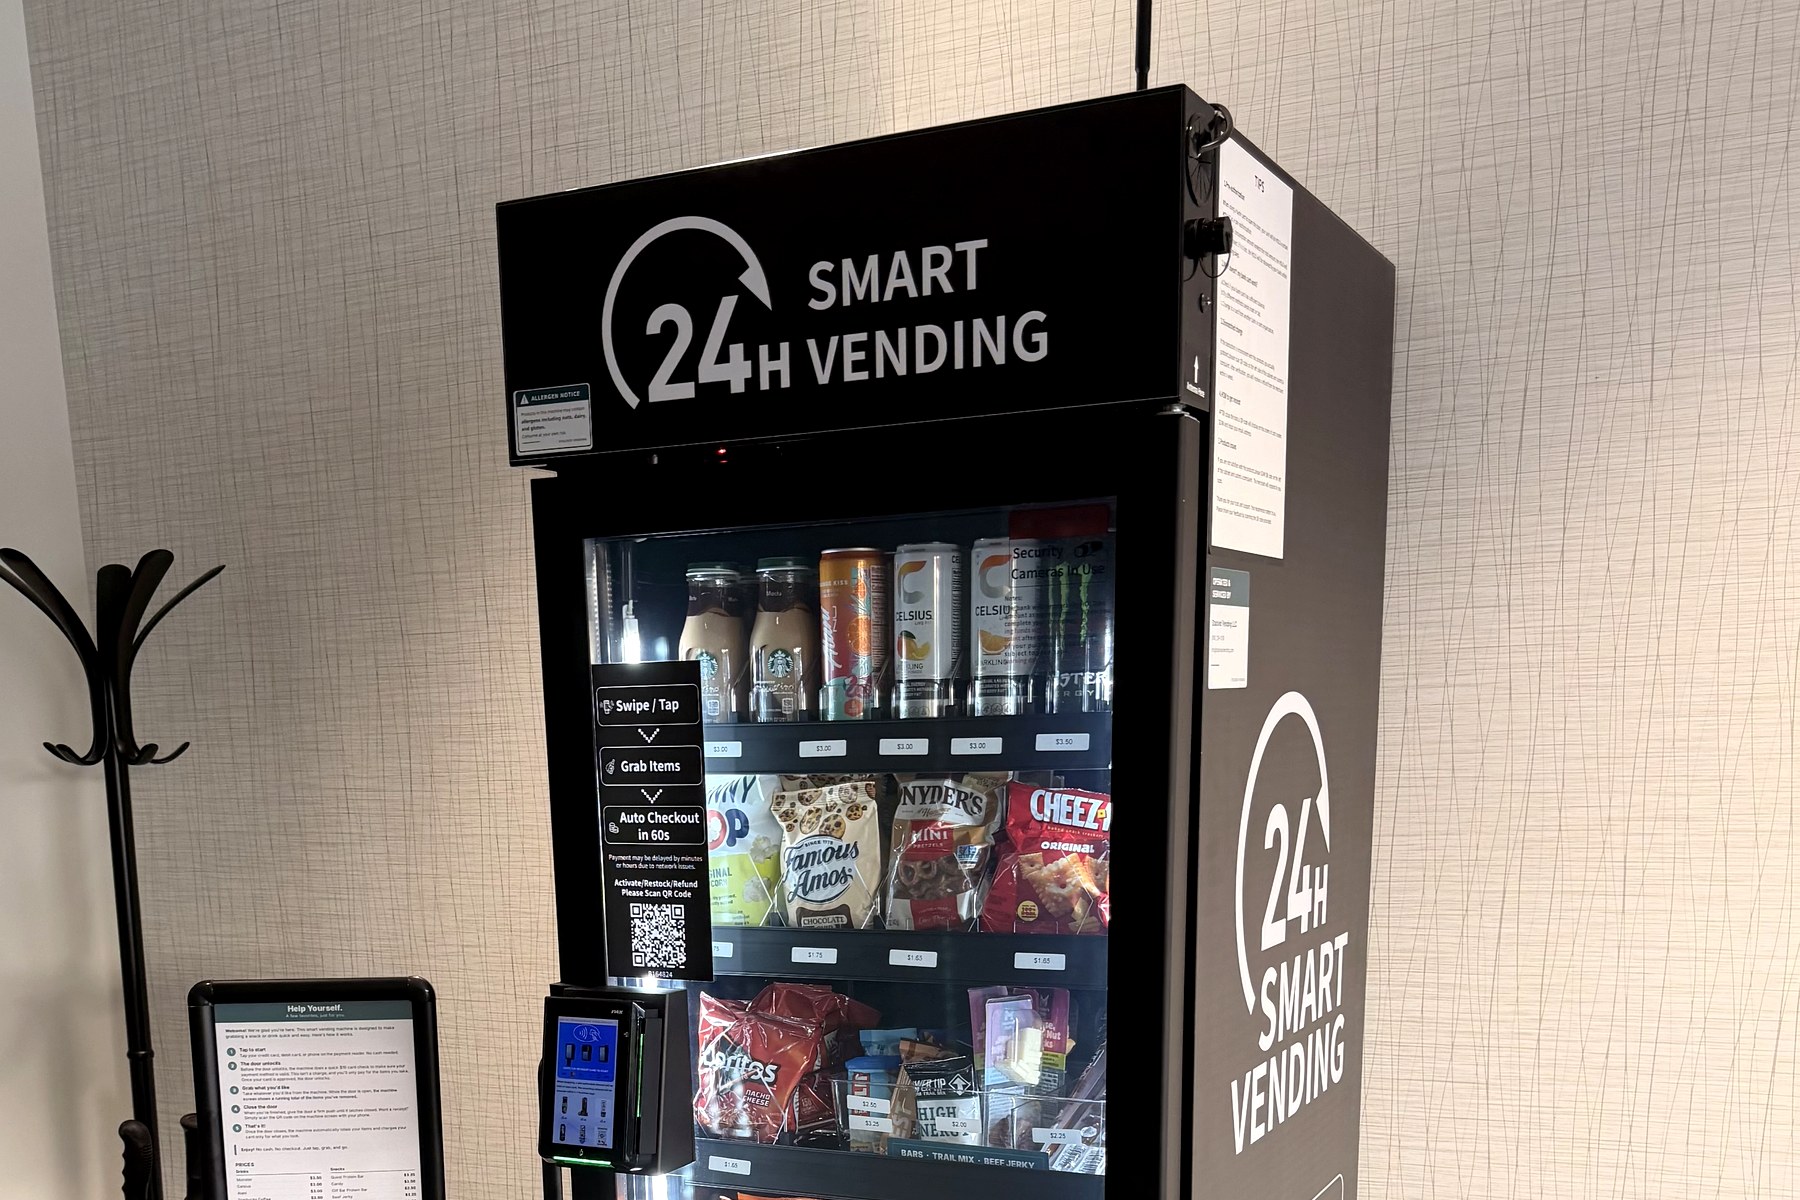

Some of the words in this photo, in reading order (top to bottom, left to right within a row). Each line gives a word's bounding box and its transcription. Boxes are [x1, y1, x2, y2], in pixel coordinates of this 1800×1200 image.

[807, 238, 988, 311] SMART
[645, 294, 790, 403] 24H
[806, 310, 1048, 385] VENDING
[1013, 545, 1063, 559] Security
[1011, 567, 1064, 580] Cameras
[1067, 564, 1077, 576] In
[1082, 563, 1105, 576] Use
[896, 610, 932, 621] CELSIUS
[615, 699, 650, 714] Swipe
[651, 698, 657, 714] /
[658, 698, 680, 713] Tap
[816, 744, 831, 752] $3.00
[969, 742, 986, 750] $3.00
[1055, 738, 1073, 746] $3.50
[620, 760, 647, 773] Grab
[649, 760, 681, 772] Items
[620, 812, 645, 824] Auto
[647, 812, 700, 824] Checkout
[638, 829, 649, 841] in
[650, 829, 670, 841] 60s
[911, 829, 949, 842] MINI
[1040, 841, 1095, 854] ORIGINAL
[608, 854, 632, 862] Payment
[651, 854, 673, 863] delayed
[673, 855, 681, 863] by
[783, 841, 860, 878] Famous
[1261, 797, 1329, 952] 24H
[614, 878, 698, 888] Activate/Restock/Refund
[787, 866, 854, 904] Amos
[621, 889, 644, 898] Please
[644, 889, 661, 898] Scan
[662, 890, 673, 898] QR
[673, 889, 692, 898] Code
[803, 916, 845, 925] CHOCOLATE
[1258, 931, 1349, 1052] SMART
[287, 1005, 306, 1013] Help
[307, 1004, 343, 1012] Yourself.
[1231, 1013, 1345, 1156] VENDING
[745, 1089, 771, 1100] NACHO
[743, 1095, 770, 1108] CHEESE
[918, 1106, 957, 1121] HIGH
[1050, 1131, 1066, 1139] $2.25
[901, 1149, 924, 1159] BARS
[932, 1151, 957, 1162] TRAIL
[957, 1154, 974, 1164] MIX
[983, 1157, 1005, 1166] BEEF
[1006, 1158, 1035, 1169] JERKY
